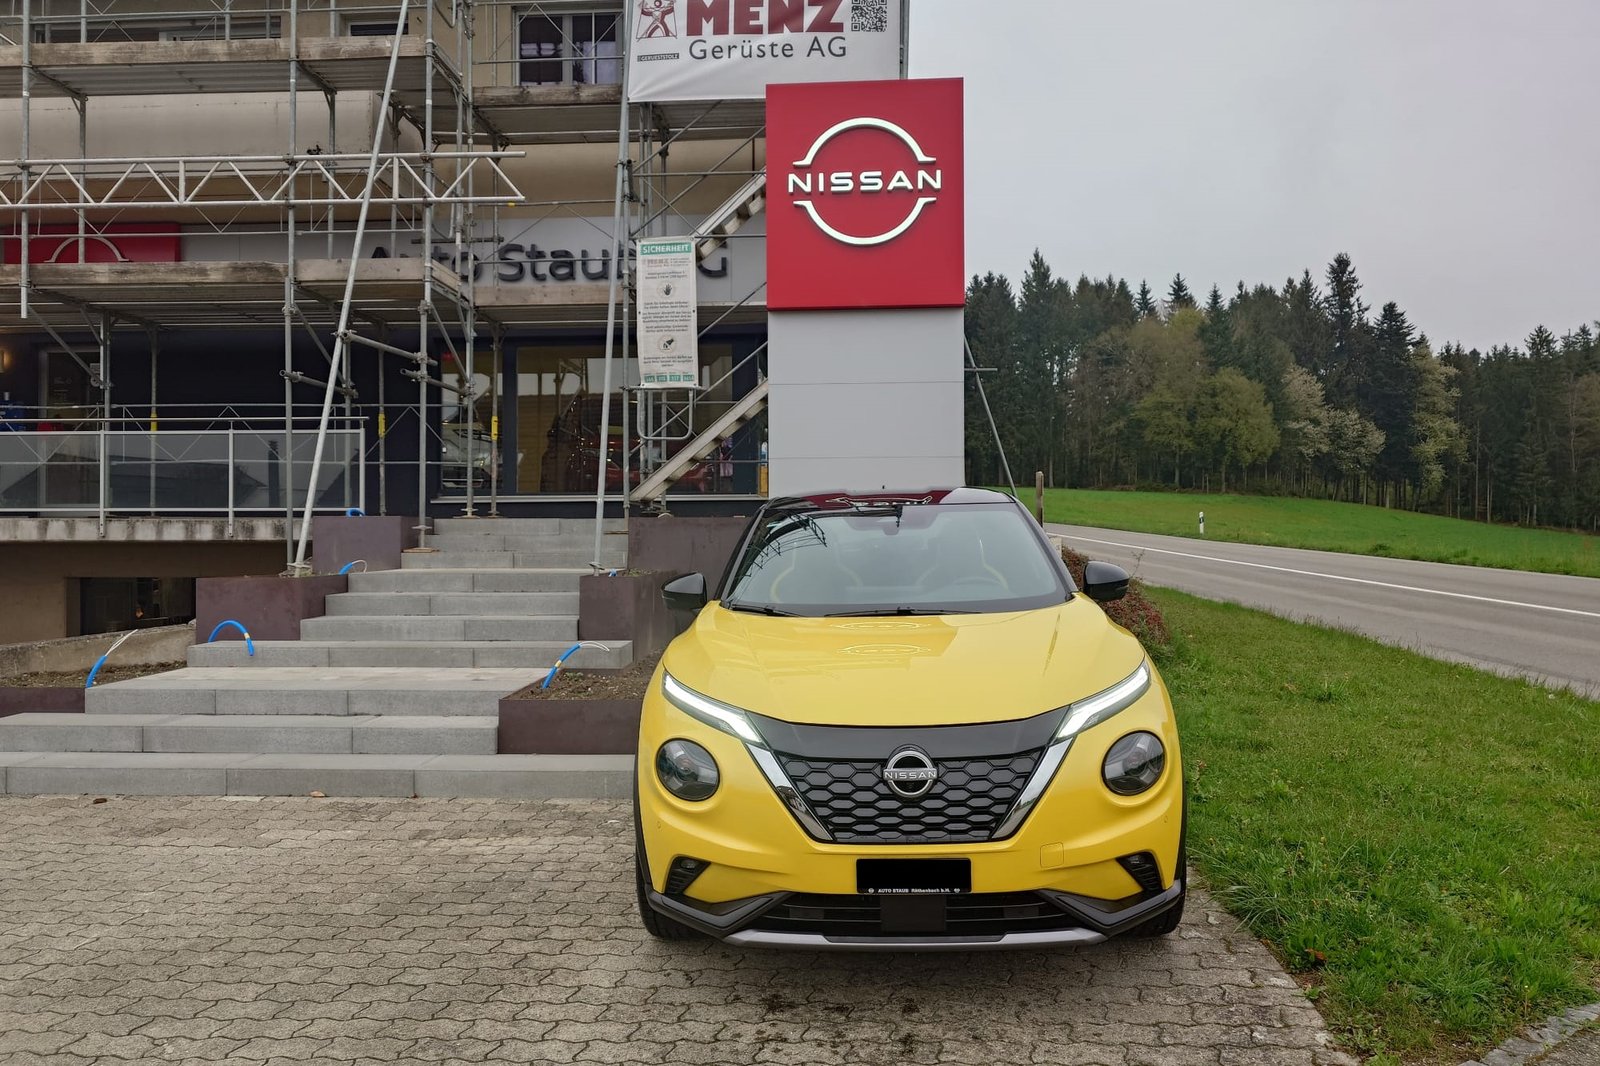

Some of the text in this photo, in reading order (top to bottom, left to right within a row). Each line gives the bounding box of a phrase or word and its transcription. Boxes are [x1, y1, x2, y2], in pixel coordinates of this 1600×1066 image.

[686, 0, 844, 36] MENZ
[688, 36, 847, 60] Gerüste AG
[788, 169, 942, 194] NISSAN
[642, 244, 689, 254] SICHERHEIT
[371, 246, 481, 282] to
[884, 770, 937, 780] NISSAN
